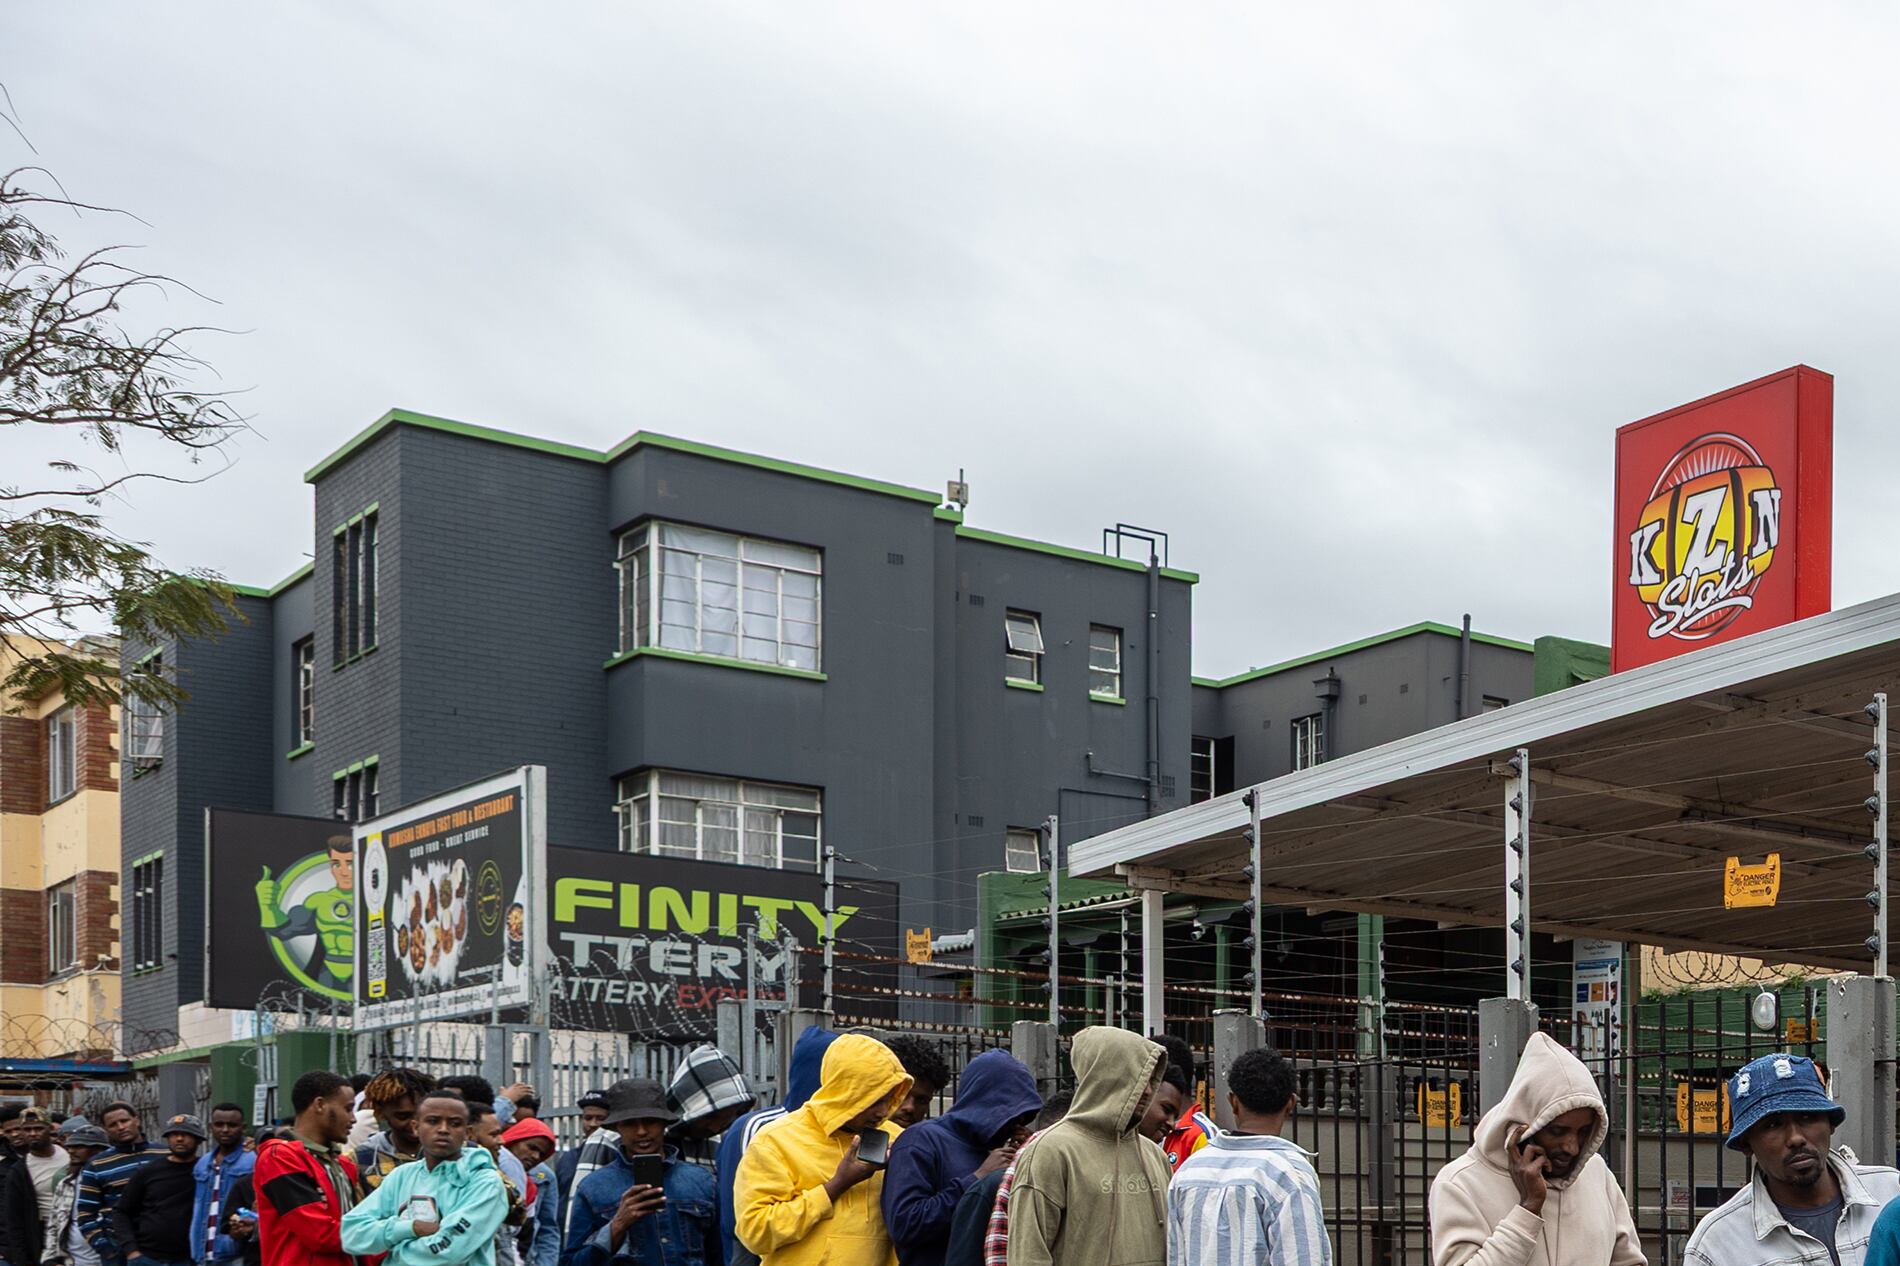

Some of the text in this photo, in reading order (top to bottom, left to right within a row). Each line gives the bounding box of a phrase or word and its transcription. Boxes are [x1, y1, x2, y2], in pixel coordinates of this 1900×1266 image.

[1629, 484, 1782, 586] KZN
[1647, 550, 1755, 639] Slots
[554, 877, 860, 946] FINITY
[1743, 873, 1776, 882] DANGER
[547, 931, 787, 982] TTERY
